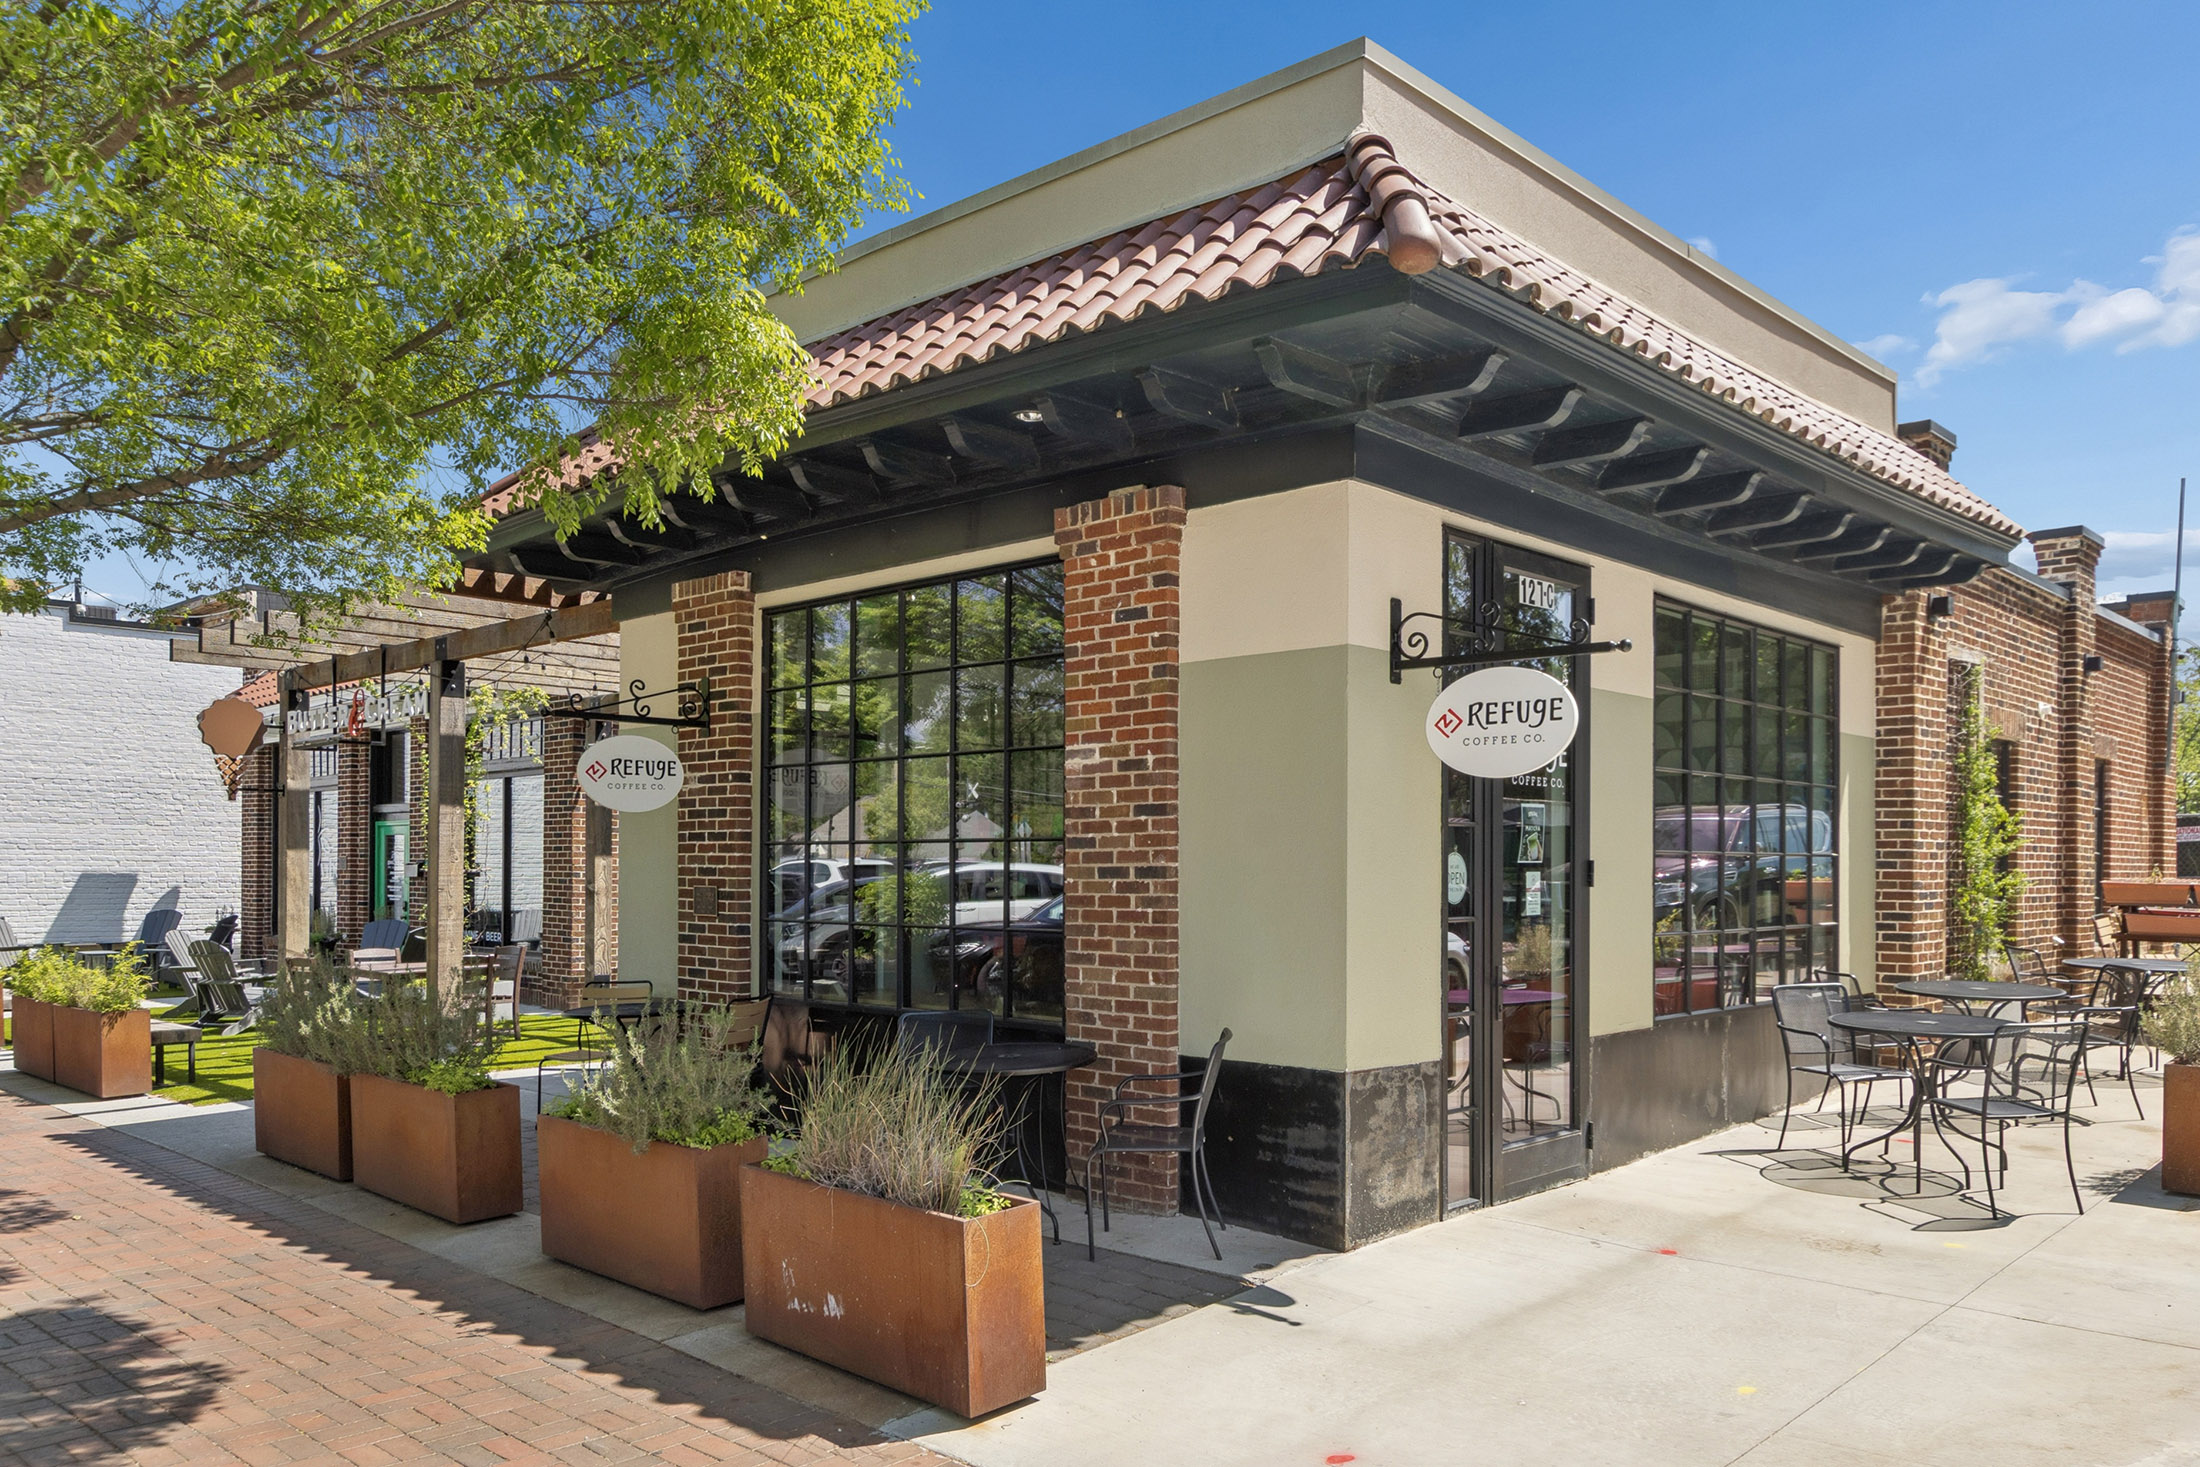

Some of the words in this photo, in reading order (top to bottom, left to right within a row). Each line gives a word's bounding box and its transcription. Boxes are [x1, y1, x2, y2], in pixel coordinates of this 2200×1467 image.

[287, 704, 349, 734] BUTTER
[364, 690, 428, 723] CREAM
[1463, 735, 1517, 746] COFFEE
[1524, 734, 1545, 743] CO.
[1512, 776, 1548, 787] COFFEE
[1550, 778, 1564, 788] CO.
[1448, 871, 1465, 884] PEN
[486, 931, 502, 942] BEER
